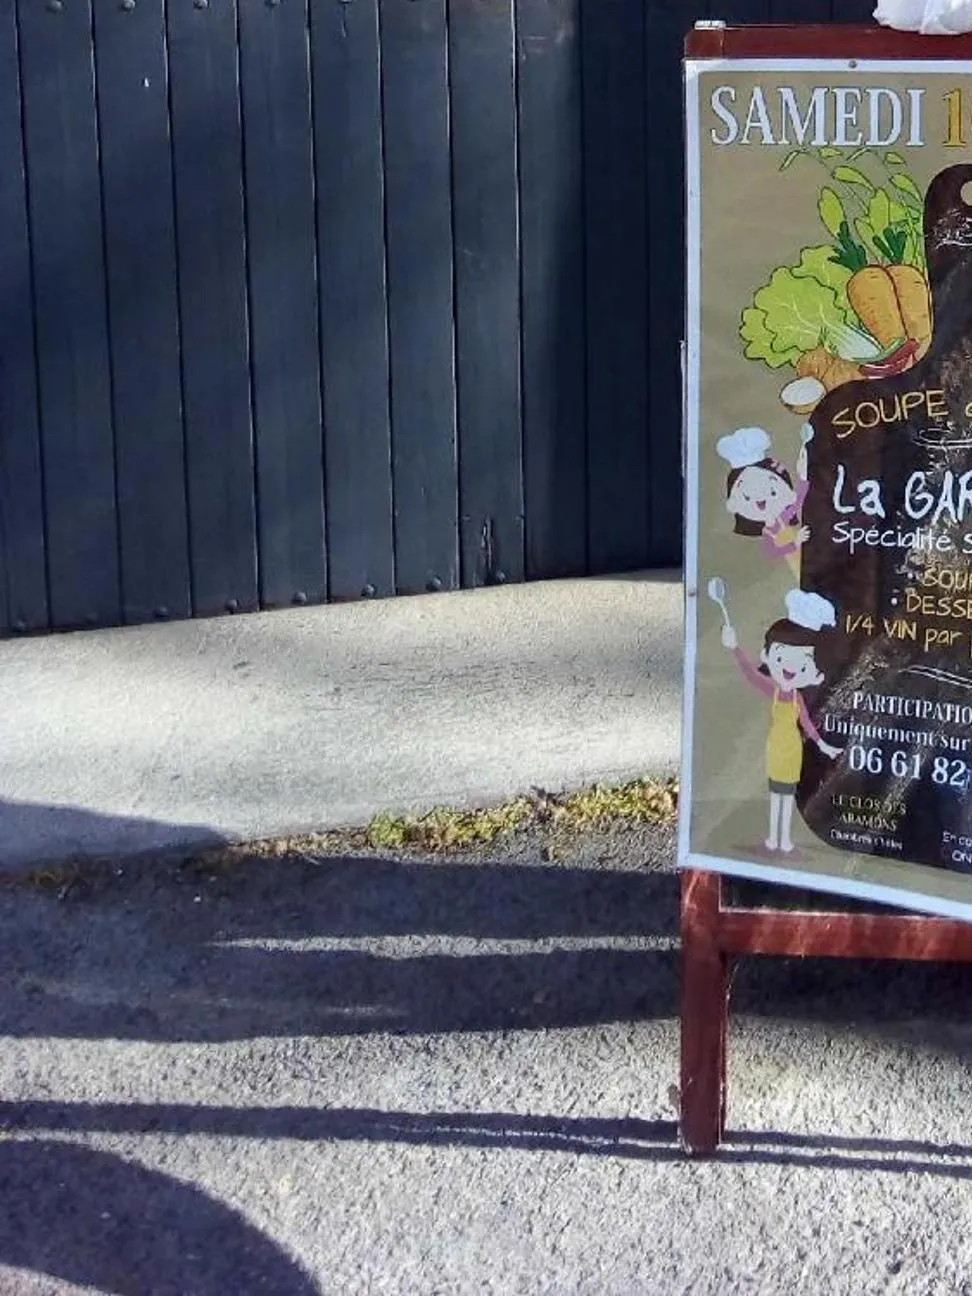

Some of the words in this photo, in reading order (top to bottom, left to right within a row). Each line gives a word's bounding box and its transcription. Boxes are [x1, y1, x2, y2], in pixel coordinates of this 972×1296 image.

[711, 86, 926, 147] SAMEDI
[832, 389, 949, 439] SOUPE
[832, 465, 886, 518] La
[832, 521, 952, 554] Spécialité
[846, 615, 874, 636] 1/4
[884, 619, 917, 641] VIN
[924, 627, 963, 654] par
[825, 713, 937, 747] Uniquement
[940, 733, 971, 751] sur
[850, 745, 883, 774] 06
[890, 750, 922, 779] 61
[931, 756, 968, 786] 82
